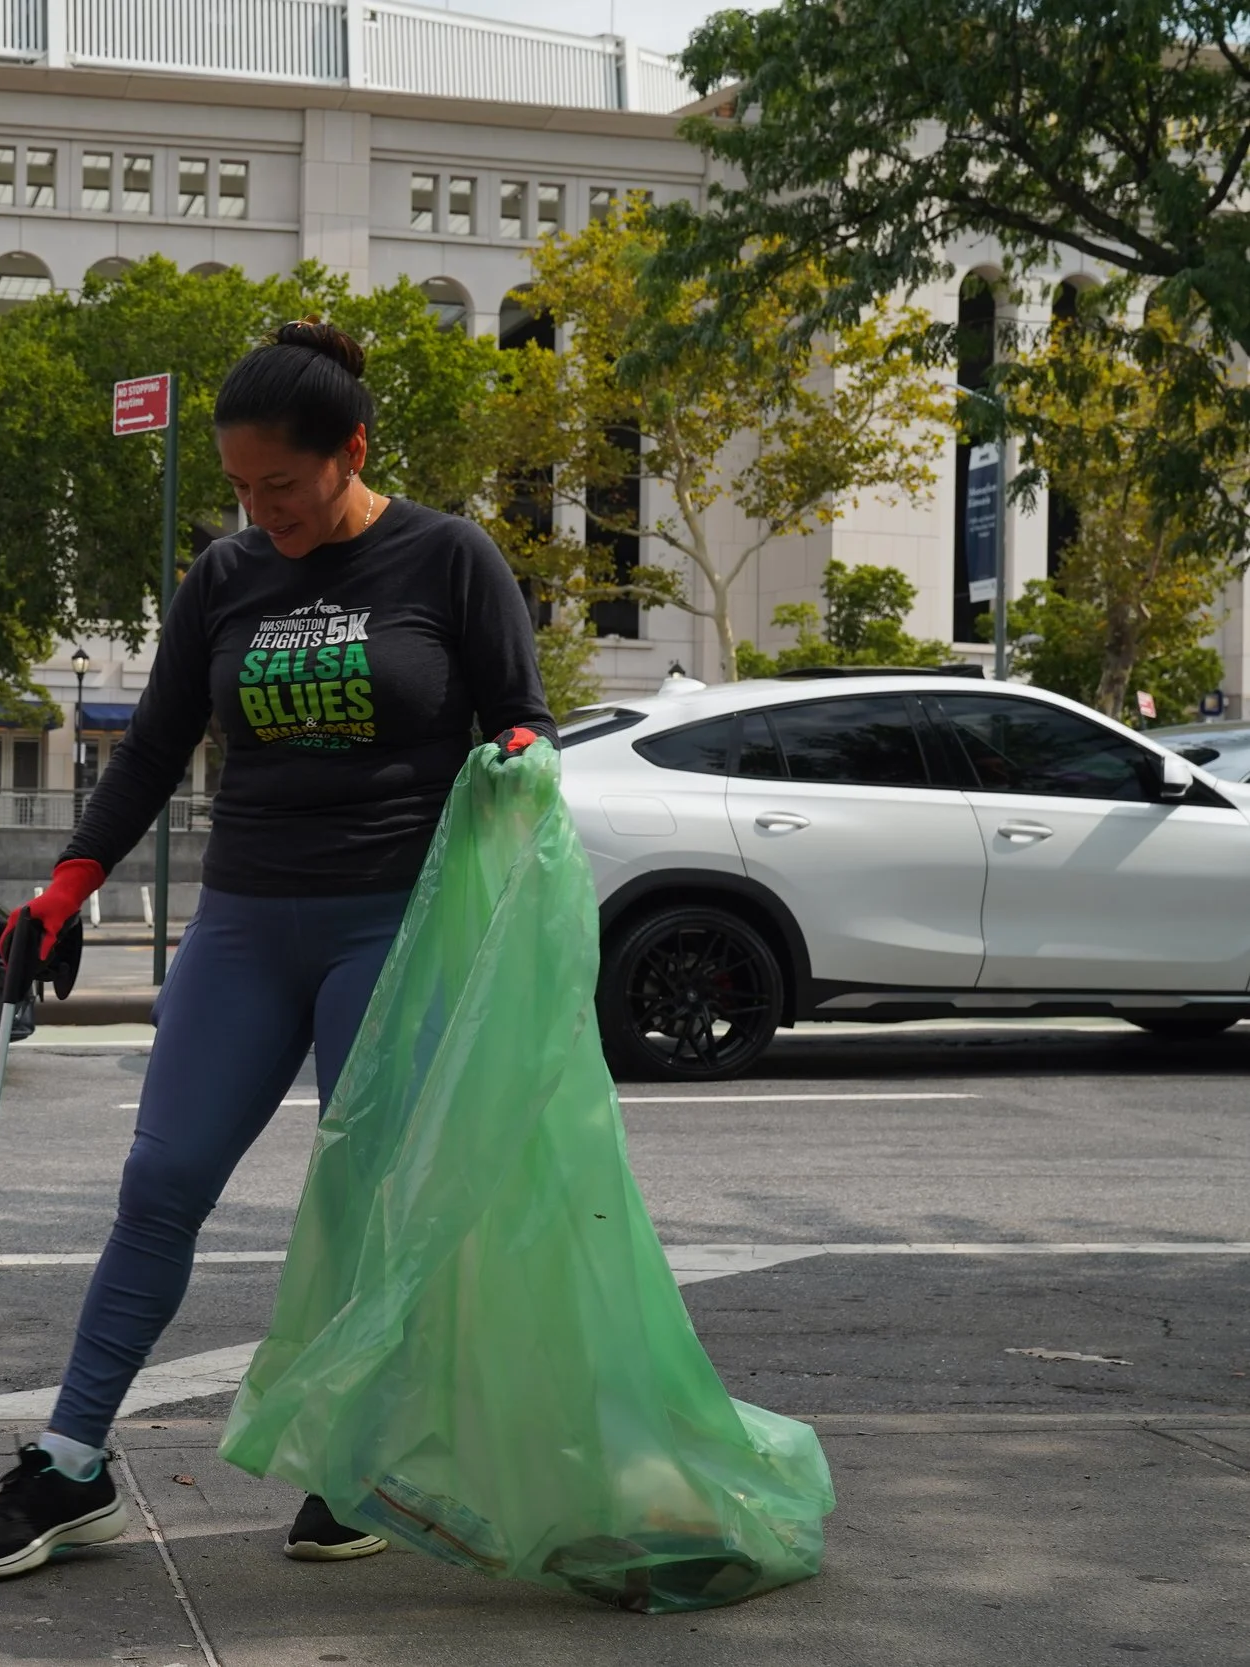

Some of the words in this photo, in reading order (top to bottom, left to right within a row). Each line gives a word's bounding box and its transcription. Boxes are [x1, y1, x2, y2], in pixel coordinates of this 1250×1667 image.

[117, 387, 127, 397] NO
[128, 381, 159, 396] STOPPING
[117, 397, 144, 410] Anytime
[260, 618, 326, 632] WASHINGTON
[325, 612, 371, 644] 5K
[250, 631, 323, 649] HEIGHTS
[239, 643, 373, 684] SALSA
[239, 678, 374, 727] BLUES
[305, 716, 318, 728] &
